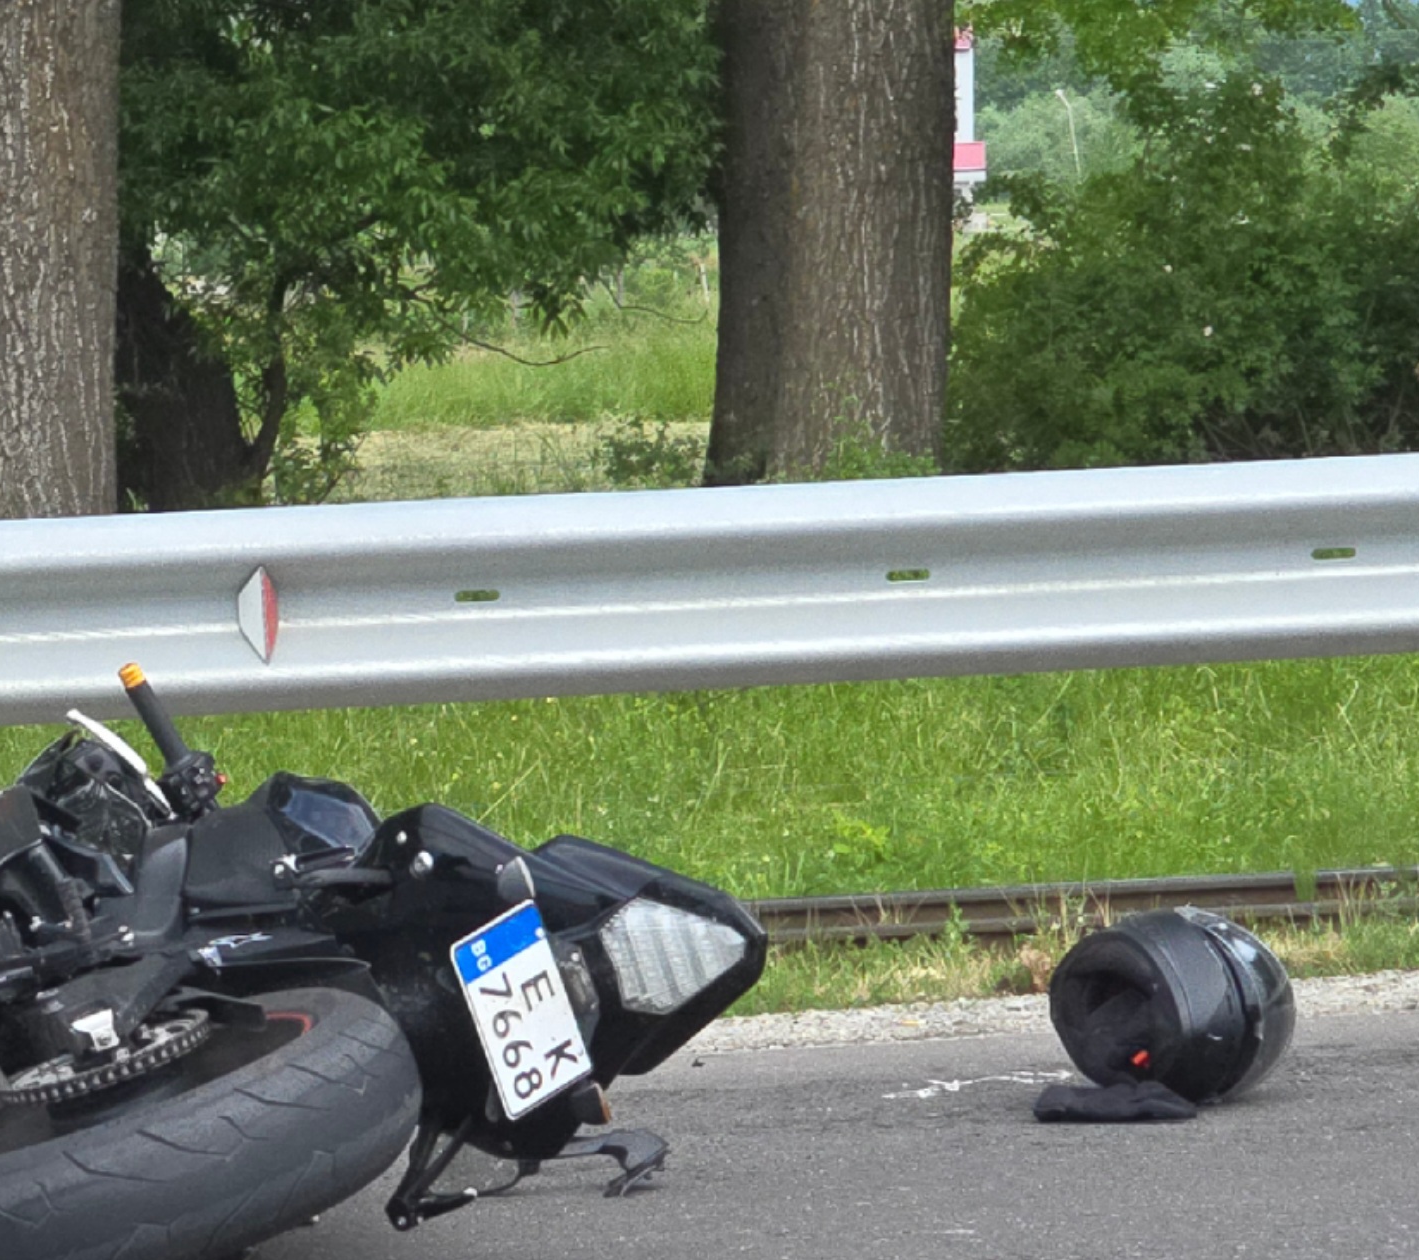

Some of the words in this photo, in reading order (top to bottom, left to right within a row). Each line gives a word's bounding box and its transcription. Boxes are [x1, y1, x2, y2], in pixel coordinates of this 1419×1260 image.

[470, 939, 493, 971] BG
[479, 971, 543, 1100] 7668
[520, 970, 556, 1013] E
[544, 1039, 579, 1079] K
